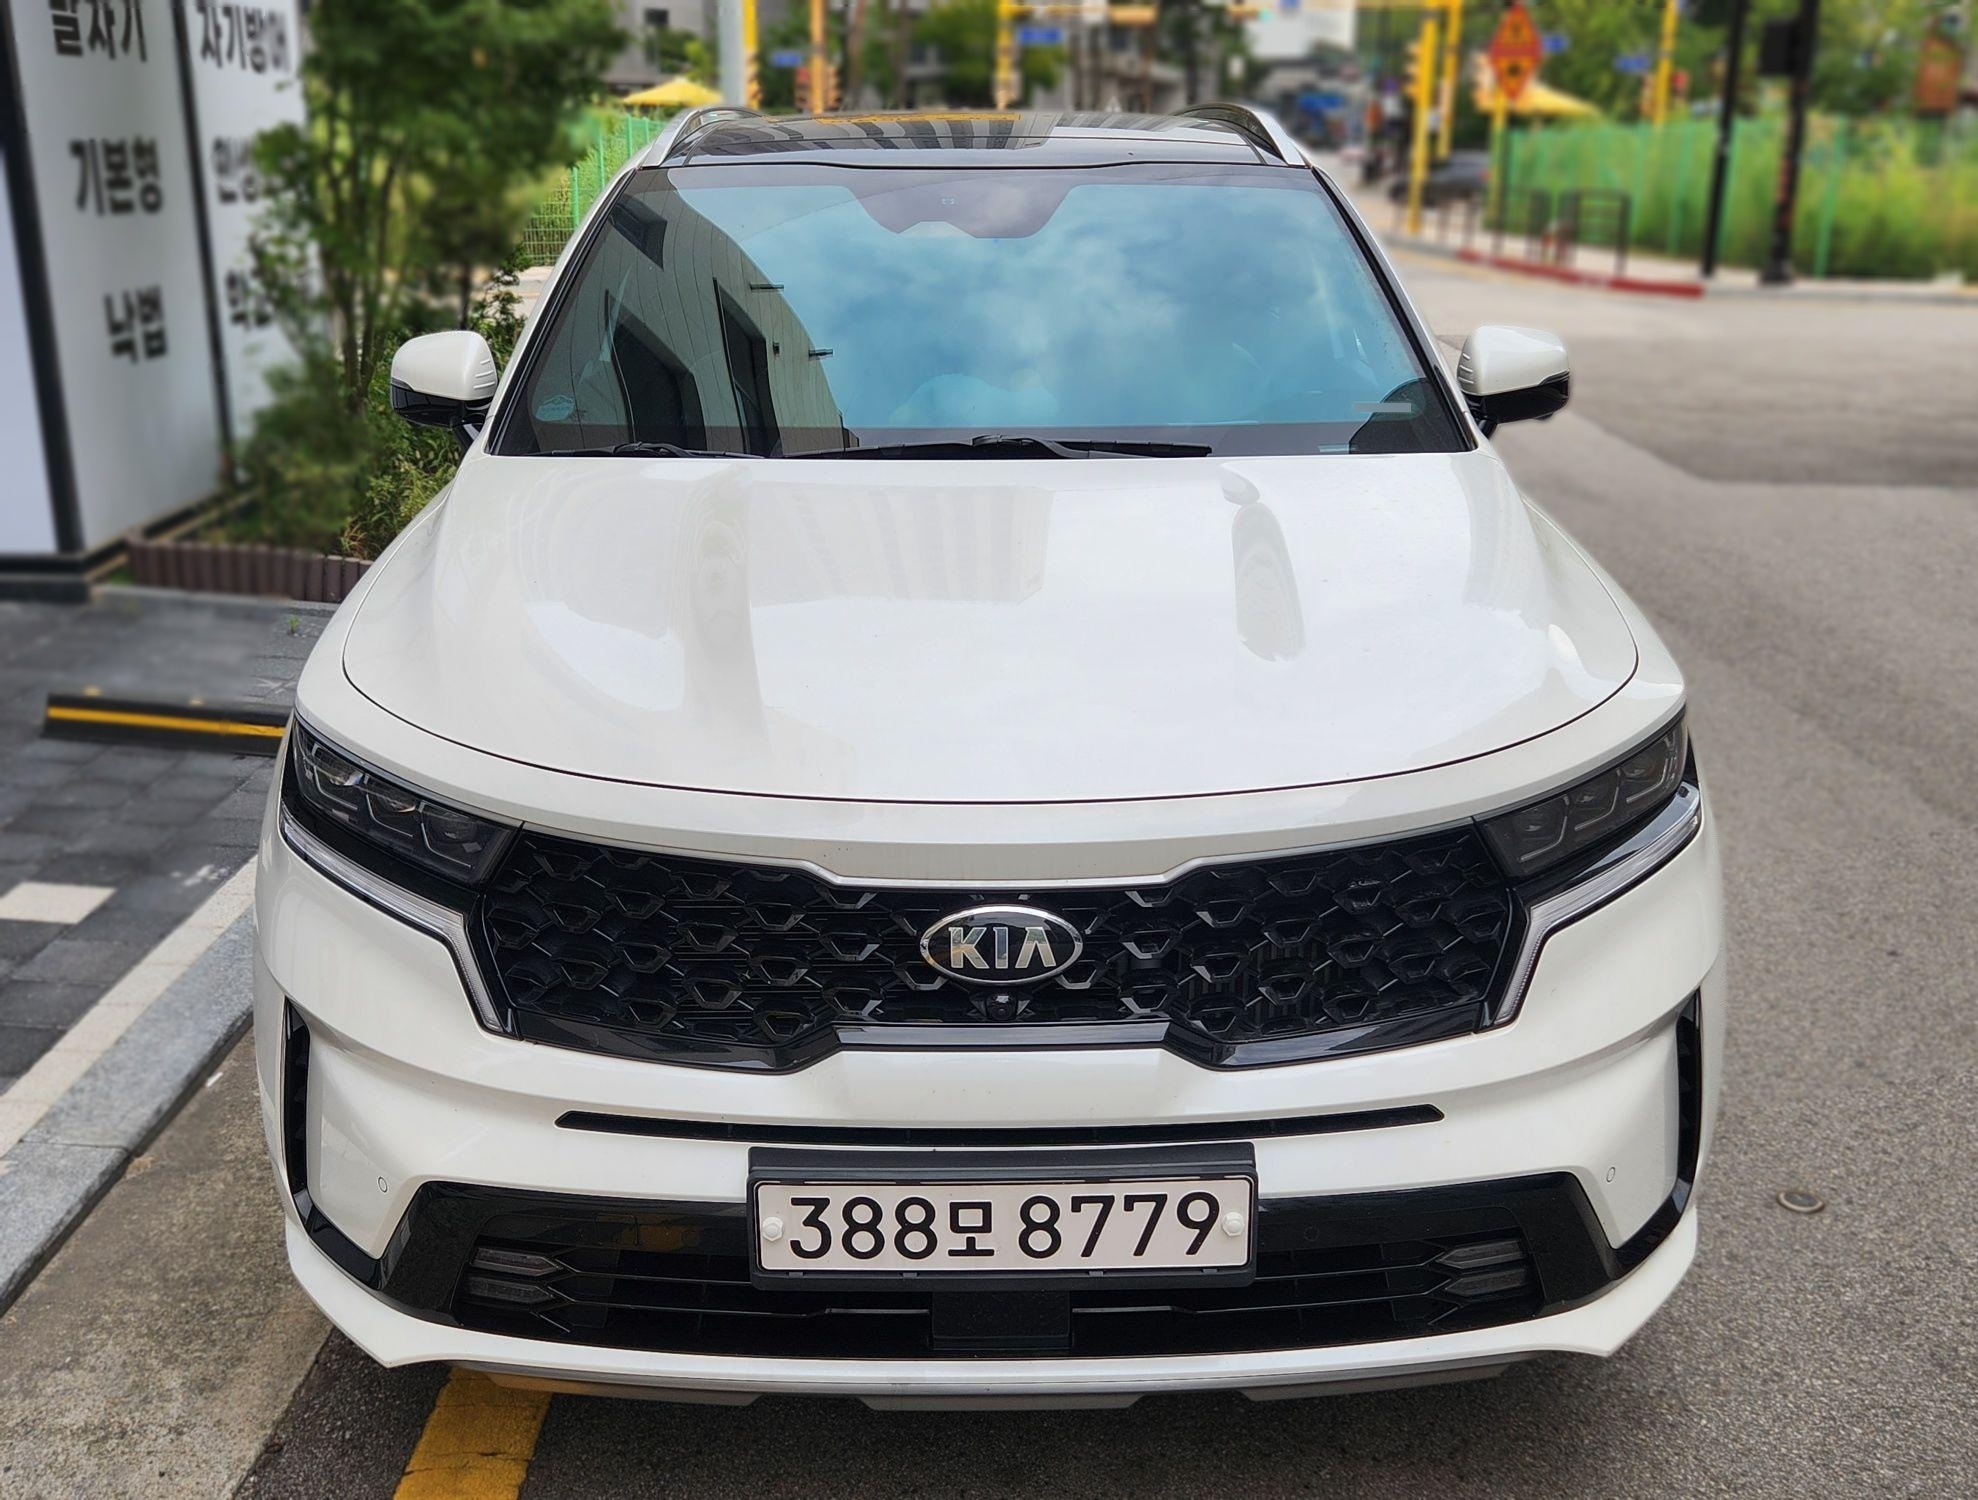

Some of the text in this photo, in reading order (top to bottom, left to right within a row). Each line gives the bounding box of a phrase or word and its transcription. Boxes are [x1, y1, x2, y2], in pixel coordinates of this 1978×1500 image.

[948, 926, 1057, 969] KIA
[789, 1190, 1220, 1260] 388모 8779
